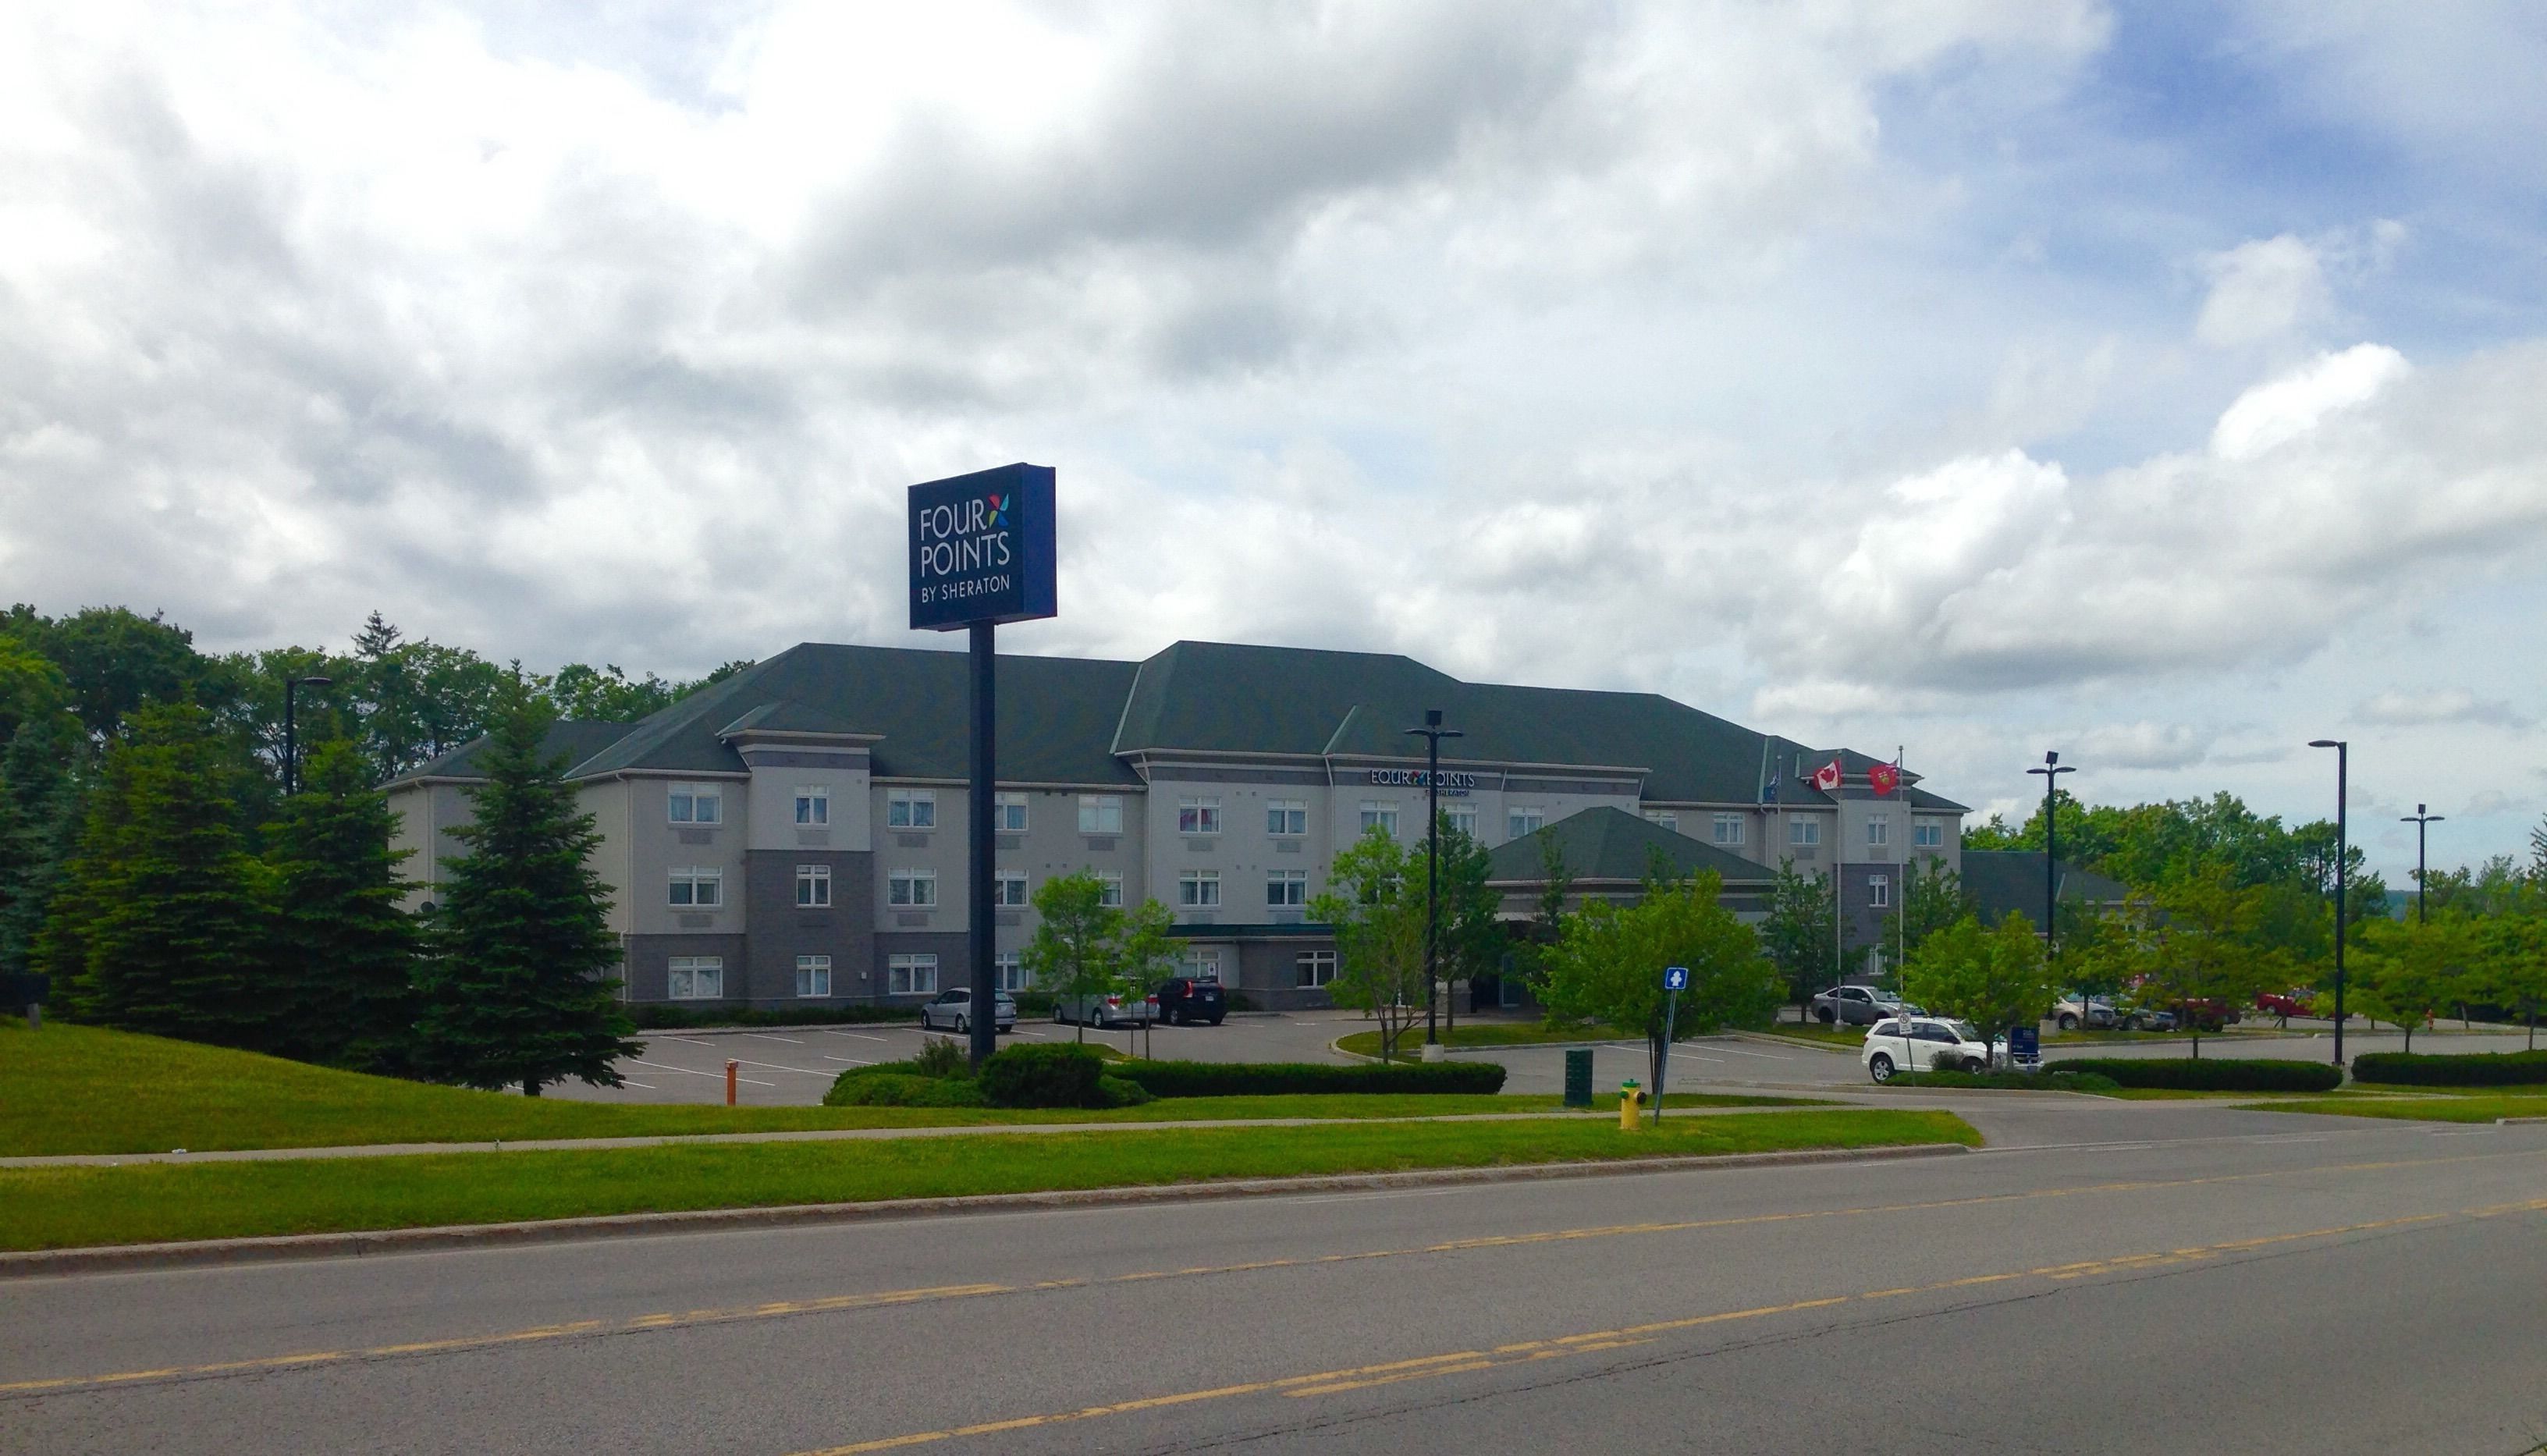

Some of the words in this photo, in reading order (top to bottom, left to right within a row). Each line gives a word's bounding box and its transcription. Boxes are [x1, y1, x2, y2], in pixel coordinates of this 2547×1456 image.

[920, 499, 987, 541] FOUR
[921, 531, 1010, 577] POINTS
[922, 586, 936, 603] BY
[942, 574, 1010, 600] SHERATON
